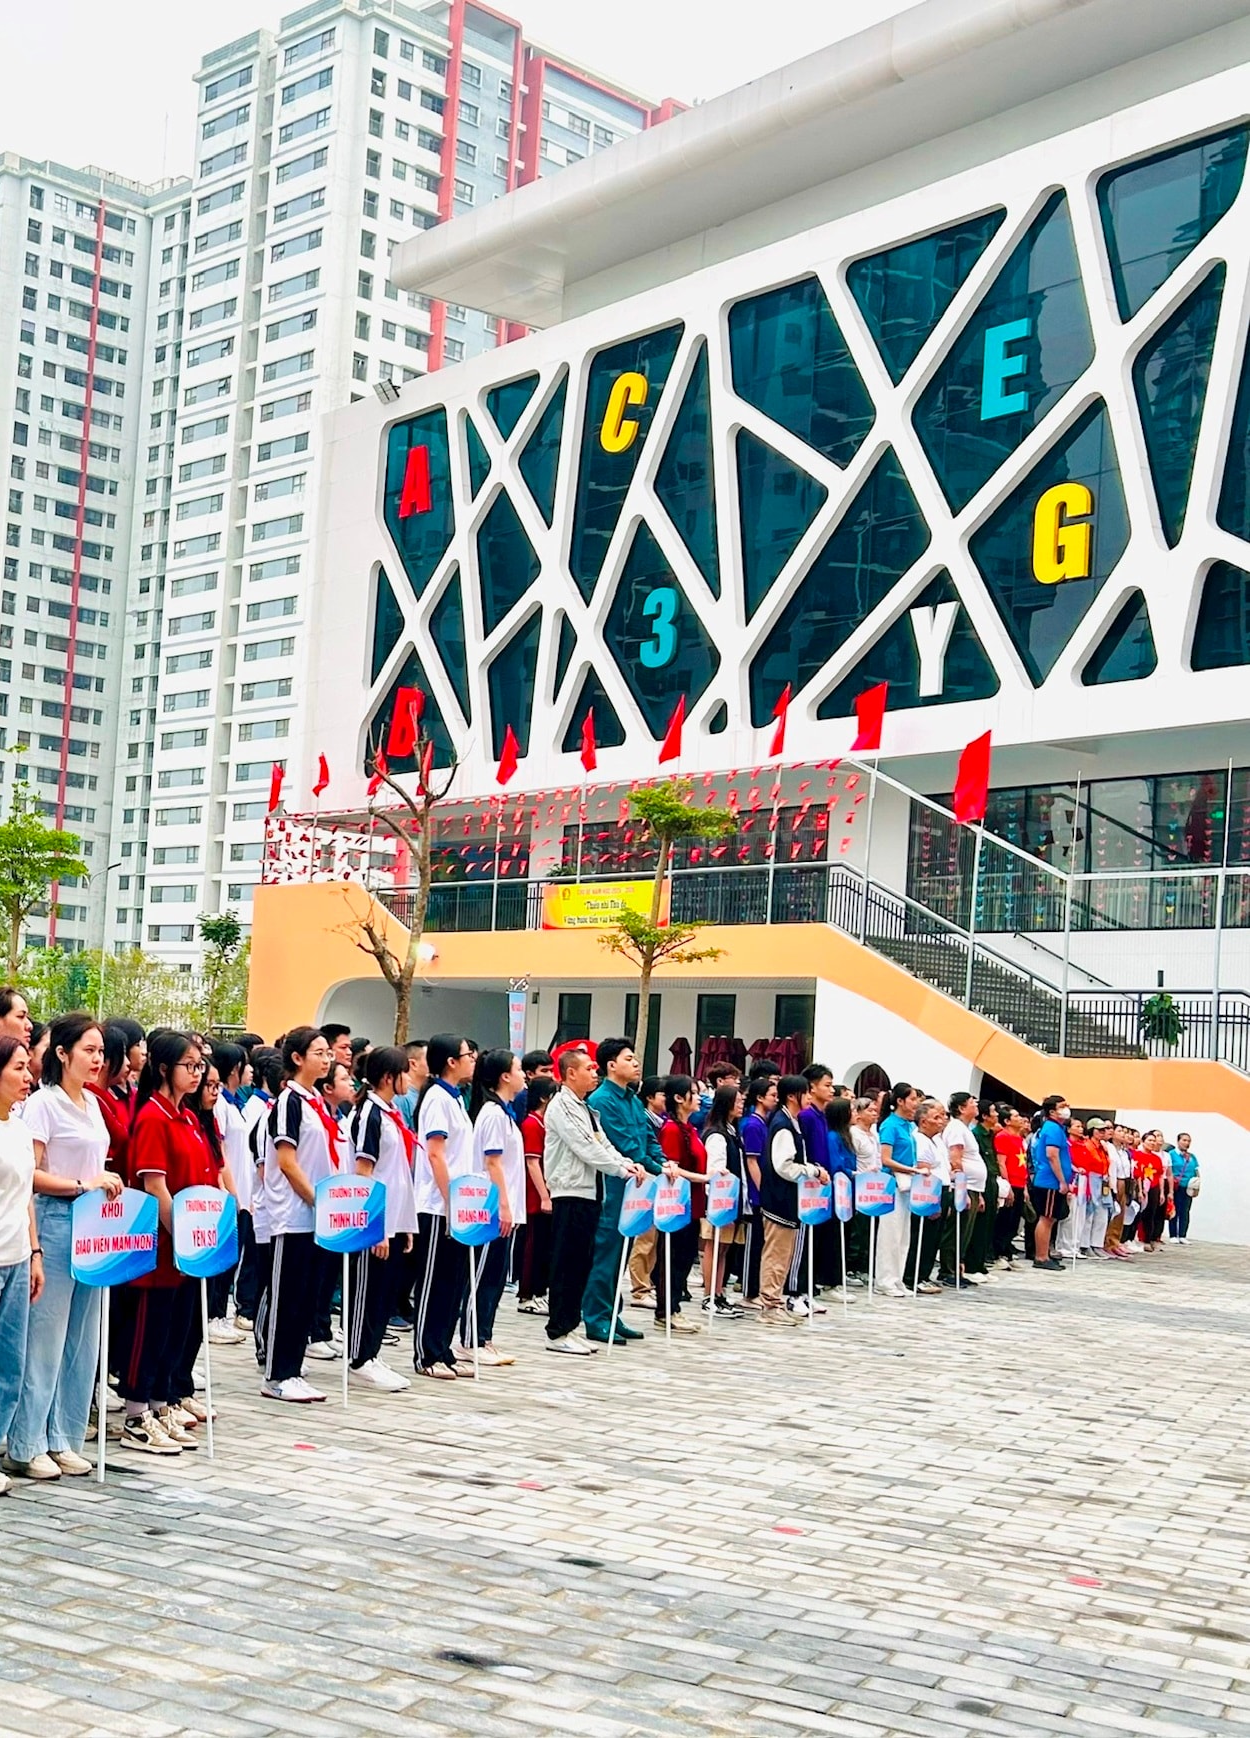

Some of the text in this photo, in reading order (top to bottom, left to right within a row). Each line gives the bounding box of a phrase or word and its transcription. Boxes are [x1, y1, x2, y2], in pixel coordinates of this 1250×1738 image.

[981, 317, 1032, 421] E
[600, 372, 648, 453] C
[399, 444, 433, 518] A
[1032, 482, 1094, 585] G
[640, 587, 679, 668] 3
[910, 602, 960, 698] Y
[208, 1200, 222, 1212] THCS
[353, 1187, 369, 1198] THCS
[478, 1209, 489, 1223] MAI
[75, 1236, 91, 1255] GIÁO
[93, 1234, 110, 1253] VIÊN
[133, 1235, 152, 1250] NON
[192, 1226, 206, 1247] YÊN
[329, 1210, 368, 1232] THỊNH LIỆT
